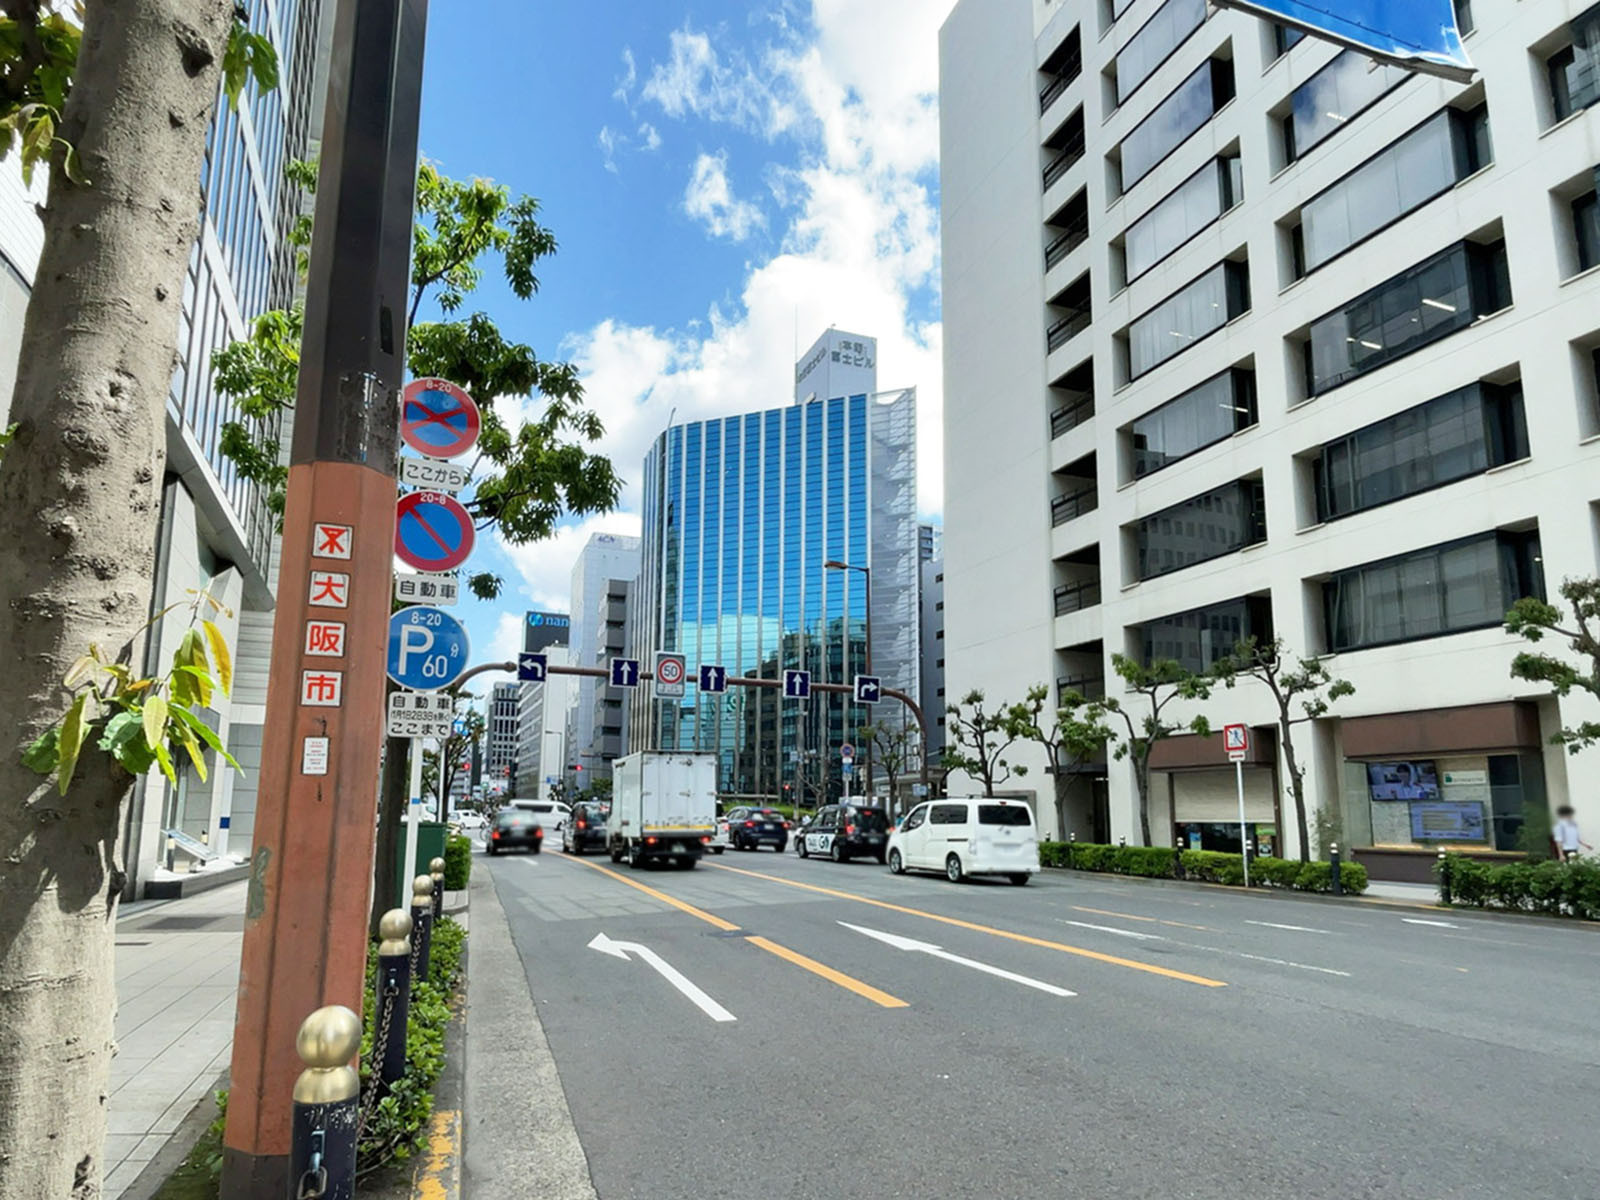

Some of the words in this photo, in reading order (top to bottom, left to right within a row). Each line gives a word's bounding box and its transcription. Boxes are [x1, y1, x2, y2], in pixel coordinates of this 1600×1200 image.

[831, 350, 874, 368] 富士ビル
[425, 380, 452, 393] 8-20
[406, 464, 462, 485] ここから
[420, 493, 447, 505] 20-8
[400, 580, 457, 599] 自動車
[411, 611, 442, 626] 8-20
[398, 623, 435, 676] P
[663, 665, 678, 677] 50
[393, 695, 450, 709] 自動車
[391, 722, 449, 735] ここまで
